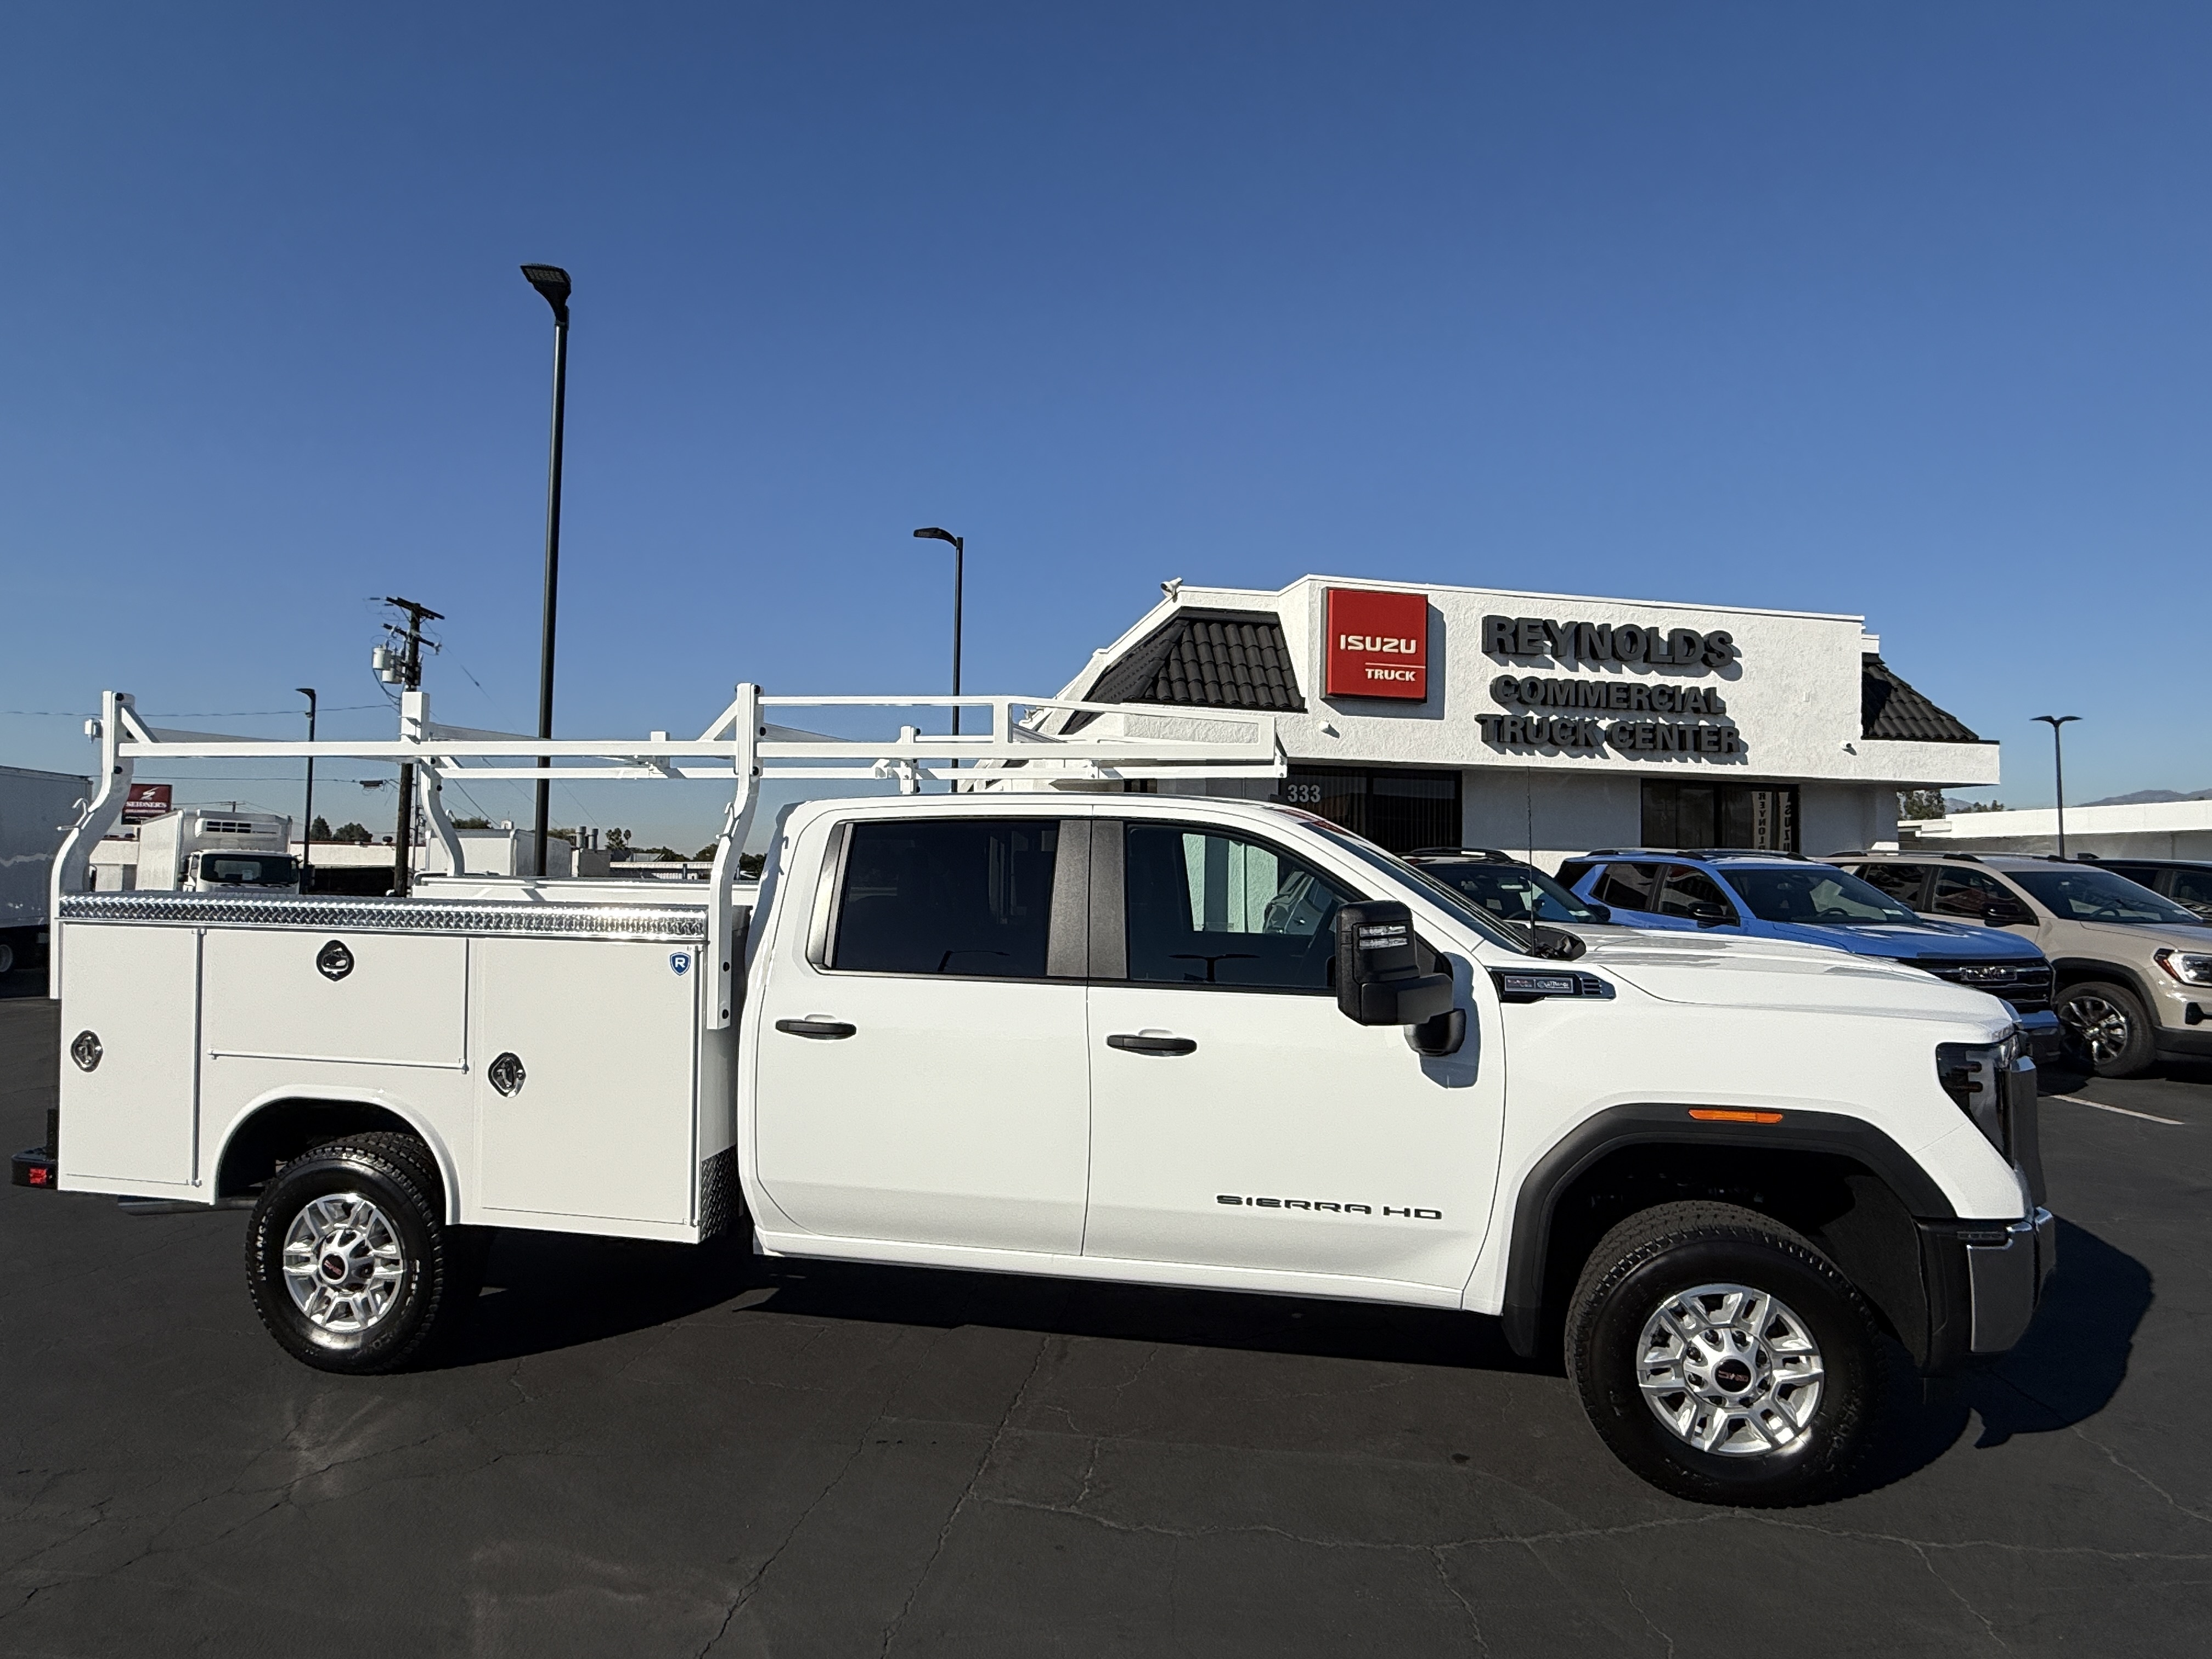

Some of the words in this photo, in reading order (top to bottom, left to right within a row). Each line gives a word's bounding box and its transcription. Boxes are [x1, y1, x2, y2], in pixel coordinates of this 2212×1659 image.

[1340, 634, 1417, 654] ISUZU
[1482, 615, 1735, 667] REYNOLDS
[1365, 668, 1417, 681] TRUCK
[1489, 675, 1726, 714] COMMERCIAL
[1475, 714, 1602, 747] TRUCK
[1605, 720, 1741, 752] CENTER
[1287, 785, 1321, 803] 333
[675, 957, 686, 968] R
[1216, 1195, 1372, 1214] SIERRA
[1383, 1206, 1442, 1220] HD
